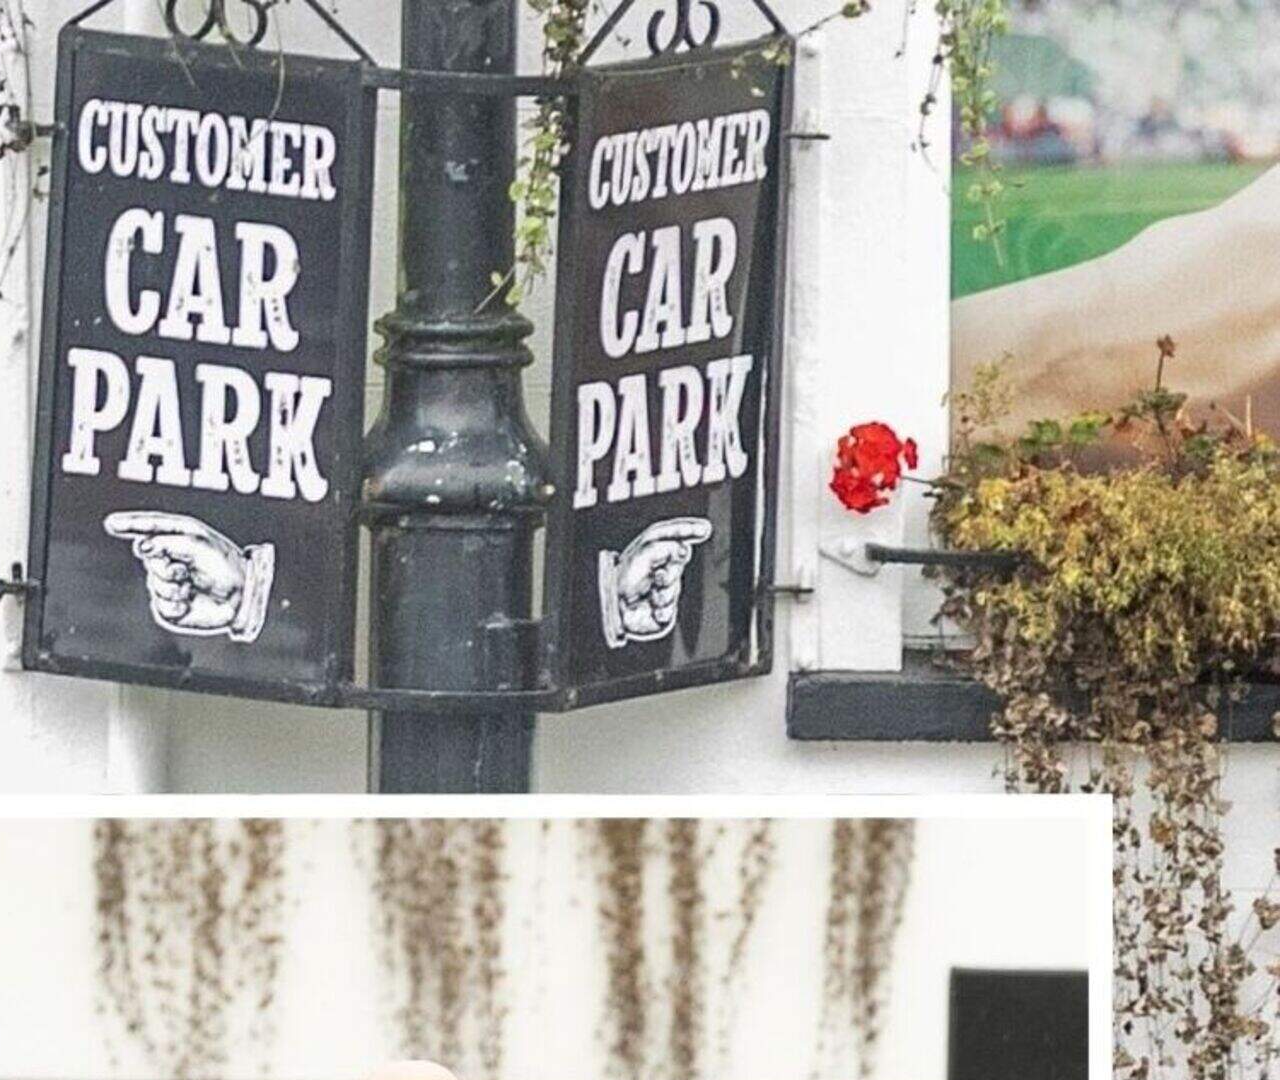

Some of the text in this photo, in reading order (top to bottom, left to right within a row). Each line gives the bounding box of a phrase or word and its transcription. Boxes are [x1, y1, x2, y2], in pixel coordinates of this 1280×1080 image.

[78, 97, 337, 201] CUSTOMER
[589, 109, 771, 210] CUSTOMER
[105, 208, 300, 352] CAR
[600, 217, 737, 358] CAR
[62, 347, 332, 502] PARK
[573, 354, 753, 509] PARK
